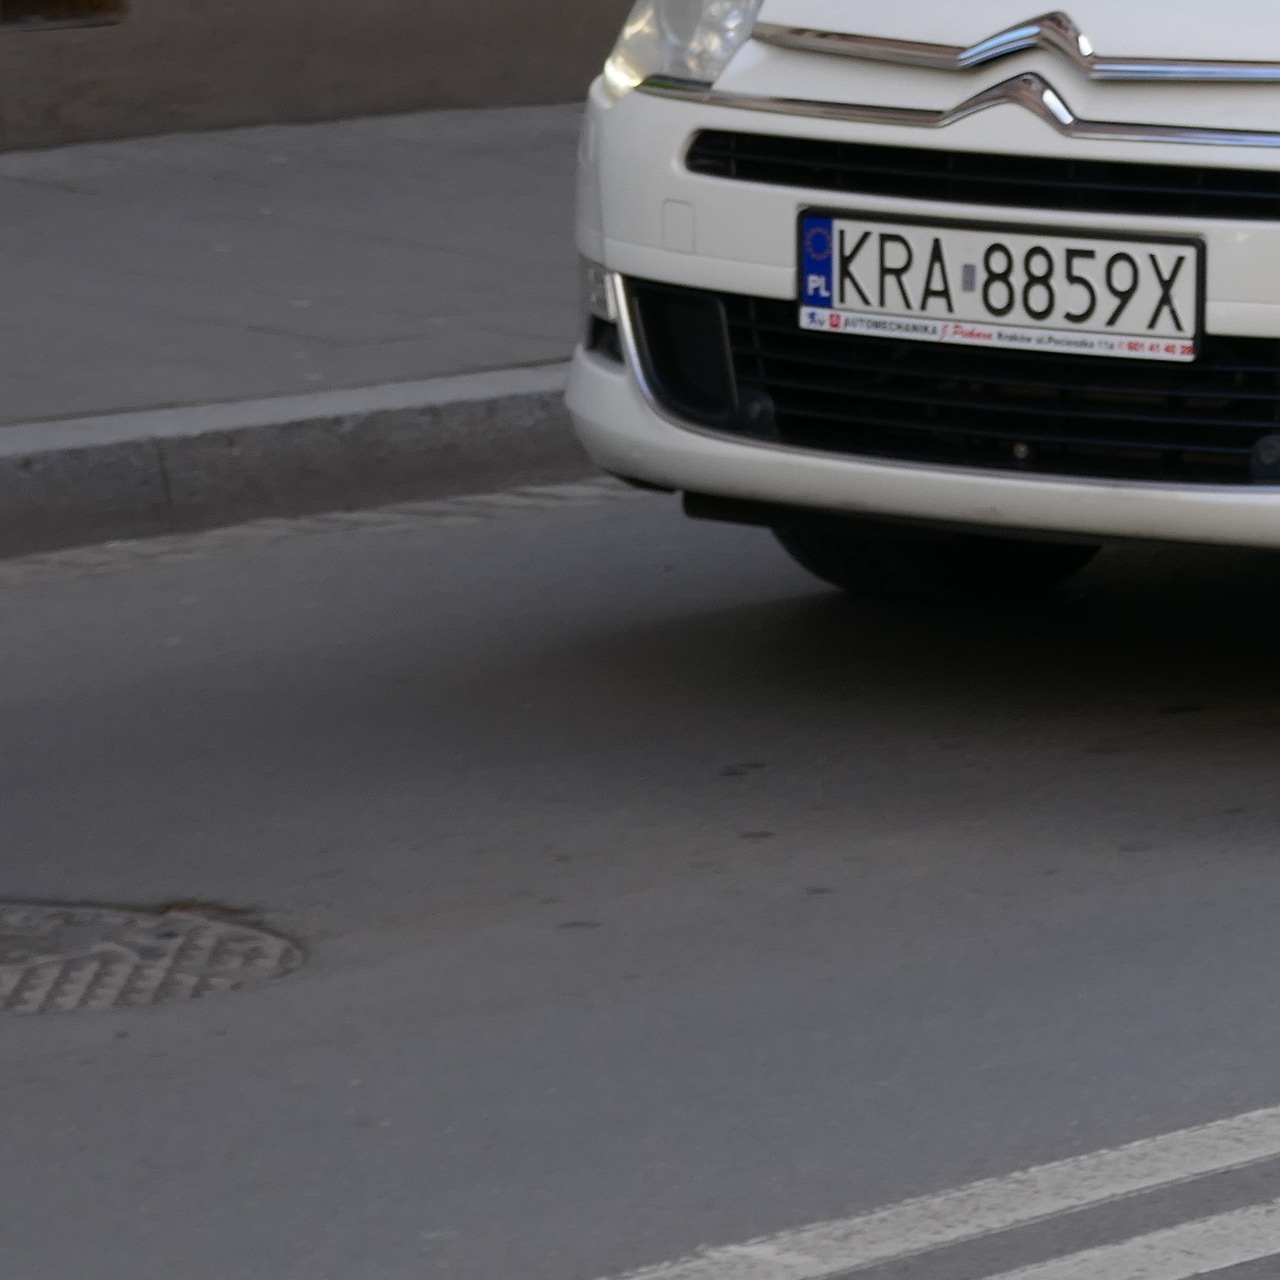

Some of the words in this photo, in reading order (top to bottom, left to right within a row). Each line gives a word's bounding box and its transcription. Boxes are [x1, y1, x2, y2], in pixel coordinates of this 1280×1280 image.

[807, 274, 831, 298] PL
[838, 229, 955, 314] KRA
[981, 242, 1187, 332] 8859X
